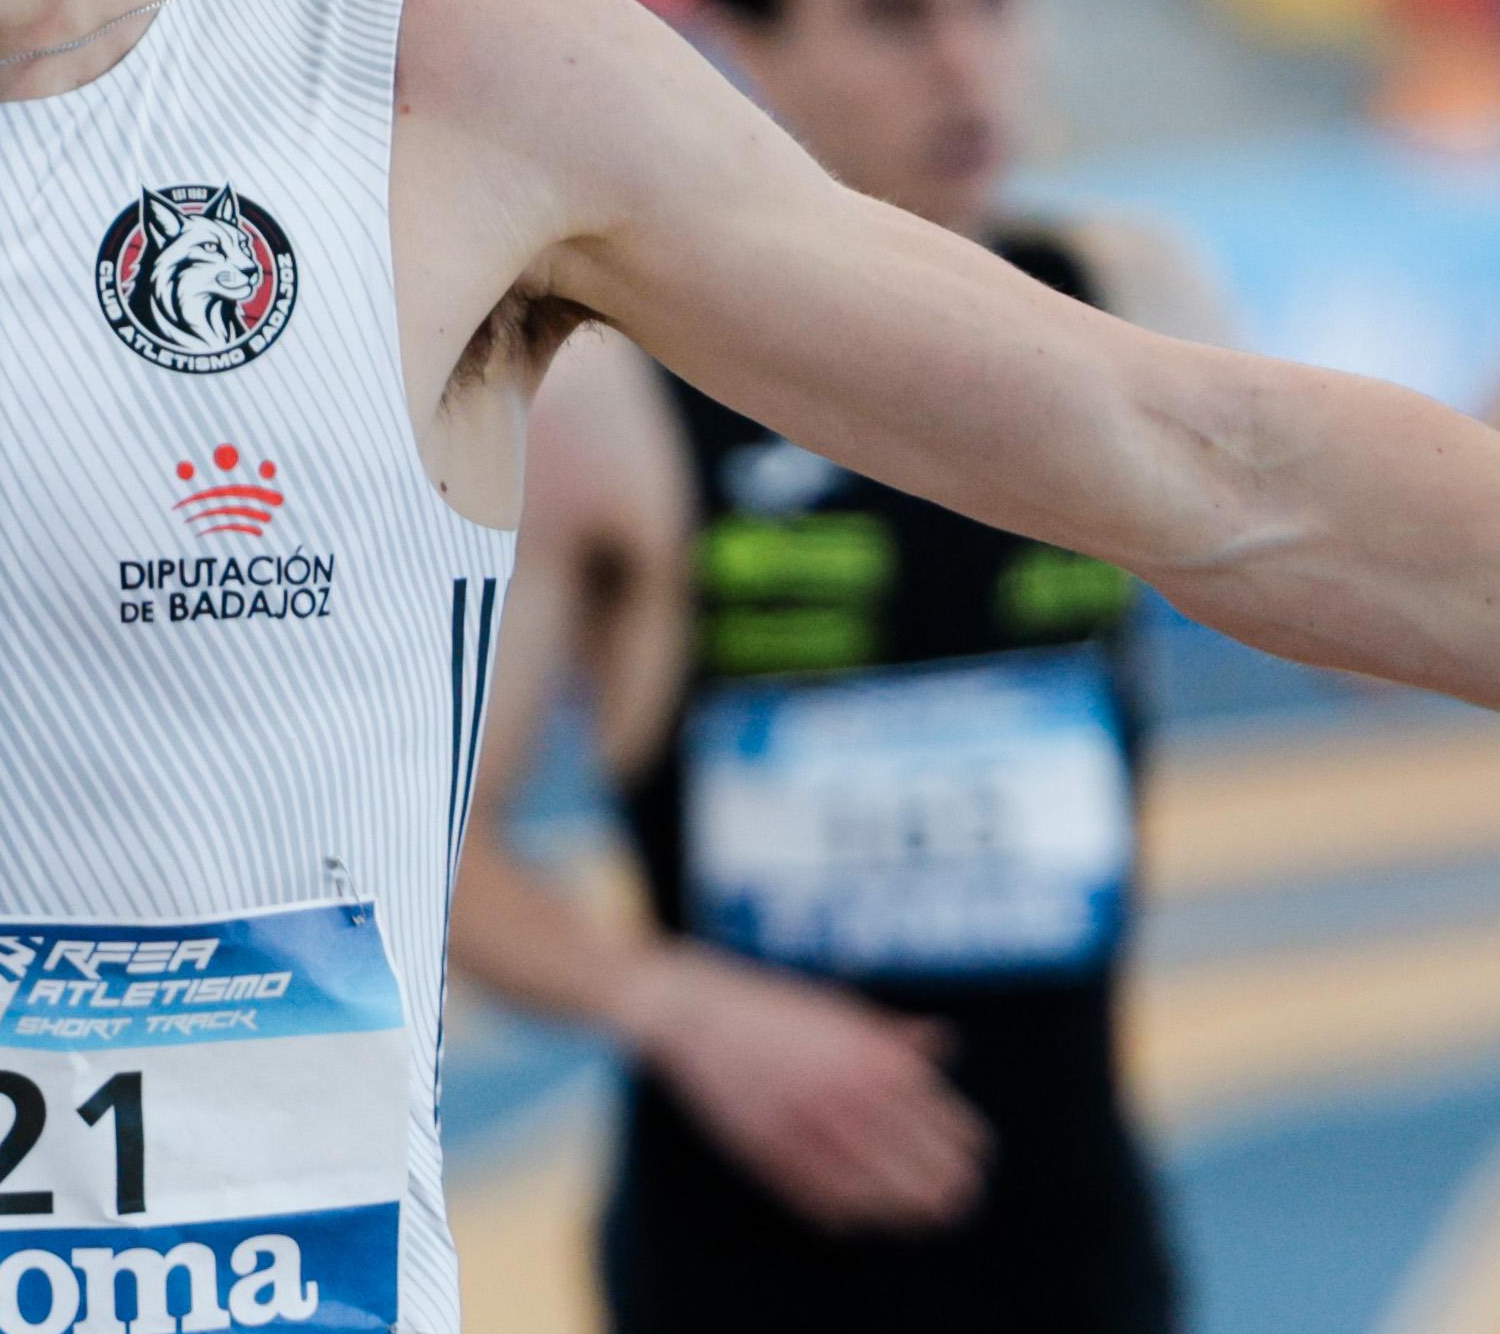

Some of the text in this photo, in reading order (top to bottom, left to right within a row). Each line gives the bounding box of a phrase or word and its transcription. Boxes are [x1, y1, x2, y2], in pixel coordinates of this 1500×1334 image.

[99, 253, 295, 371] CLUB ATLETISMO BADAJOZ
[119, 545, 335, 590] DIPUTACIÓN
[120, 587, 330, 623] DE BADAJOZ
[43, 937, 221, 980] RFEA
[26, 970, 294, 1008] ATLETISMO
[14, 1008, 259, 1041] SHORT TRACK
